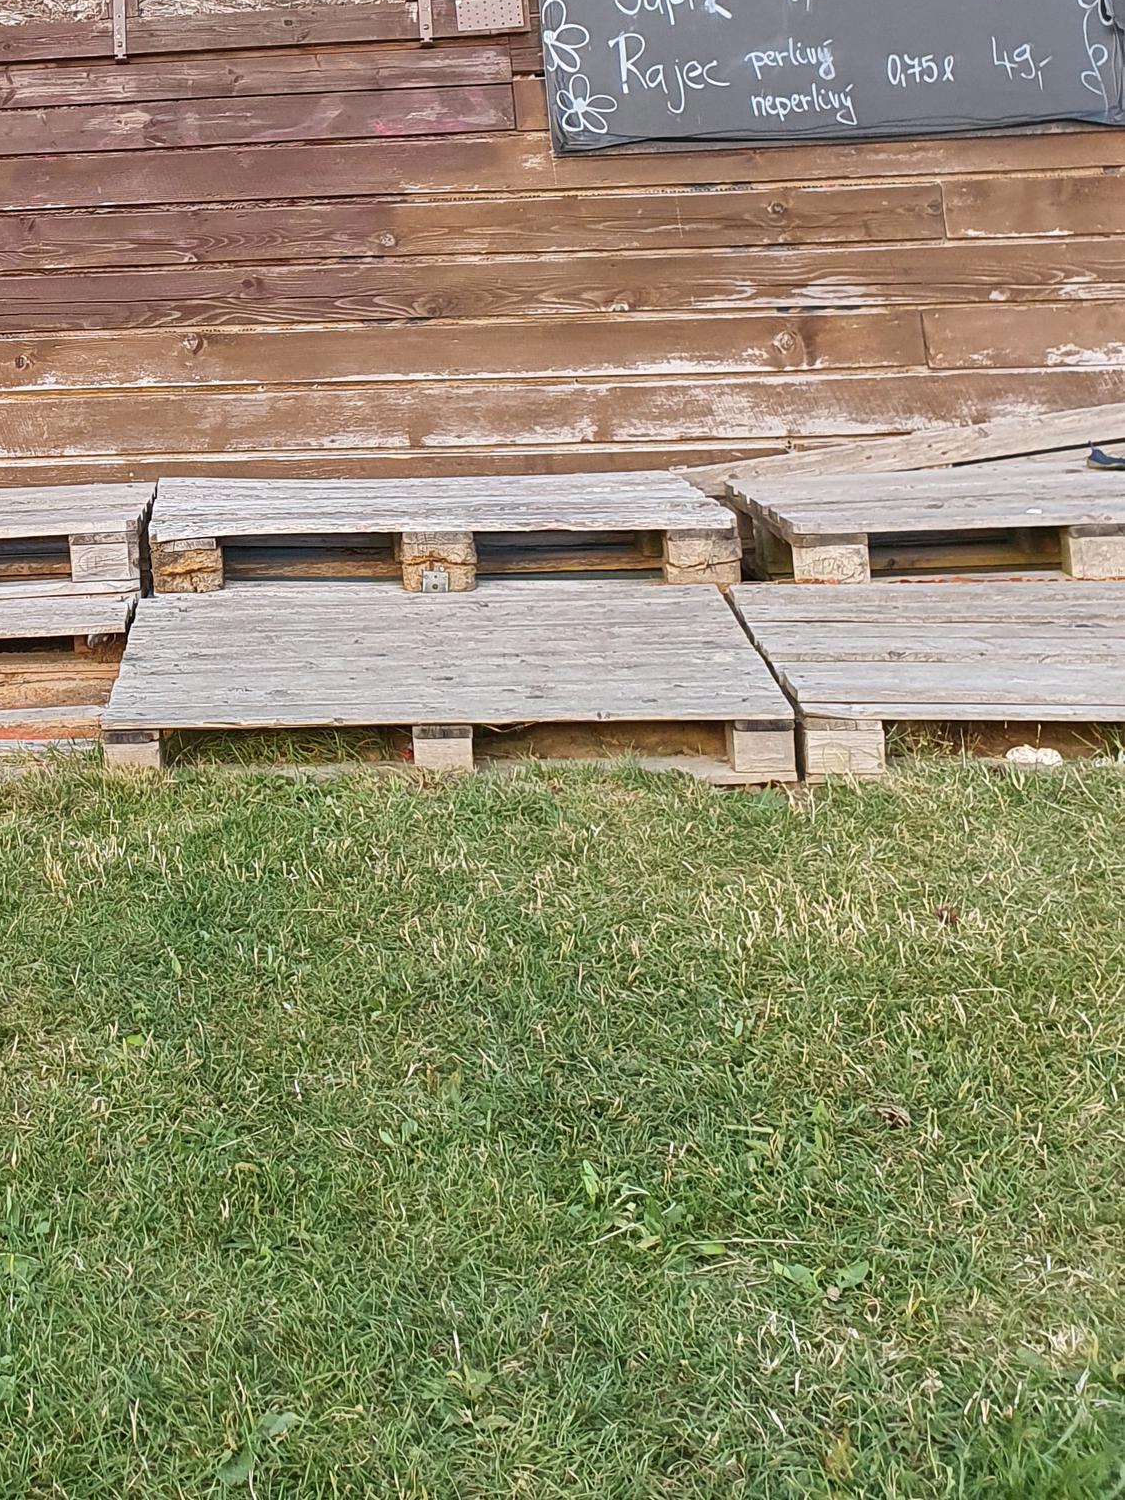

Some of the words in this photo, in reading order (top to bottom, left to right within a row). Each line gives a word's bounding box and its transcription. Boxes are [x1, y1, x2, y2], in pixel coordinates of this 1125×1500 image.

[608, 32, 731, 114] Rajec
[744, 37, 836, 80] perlivý
[751, 83, 858, 126] neperlivý
